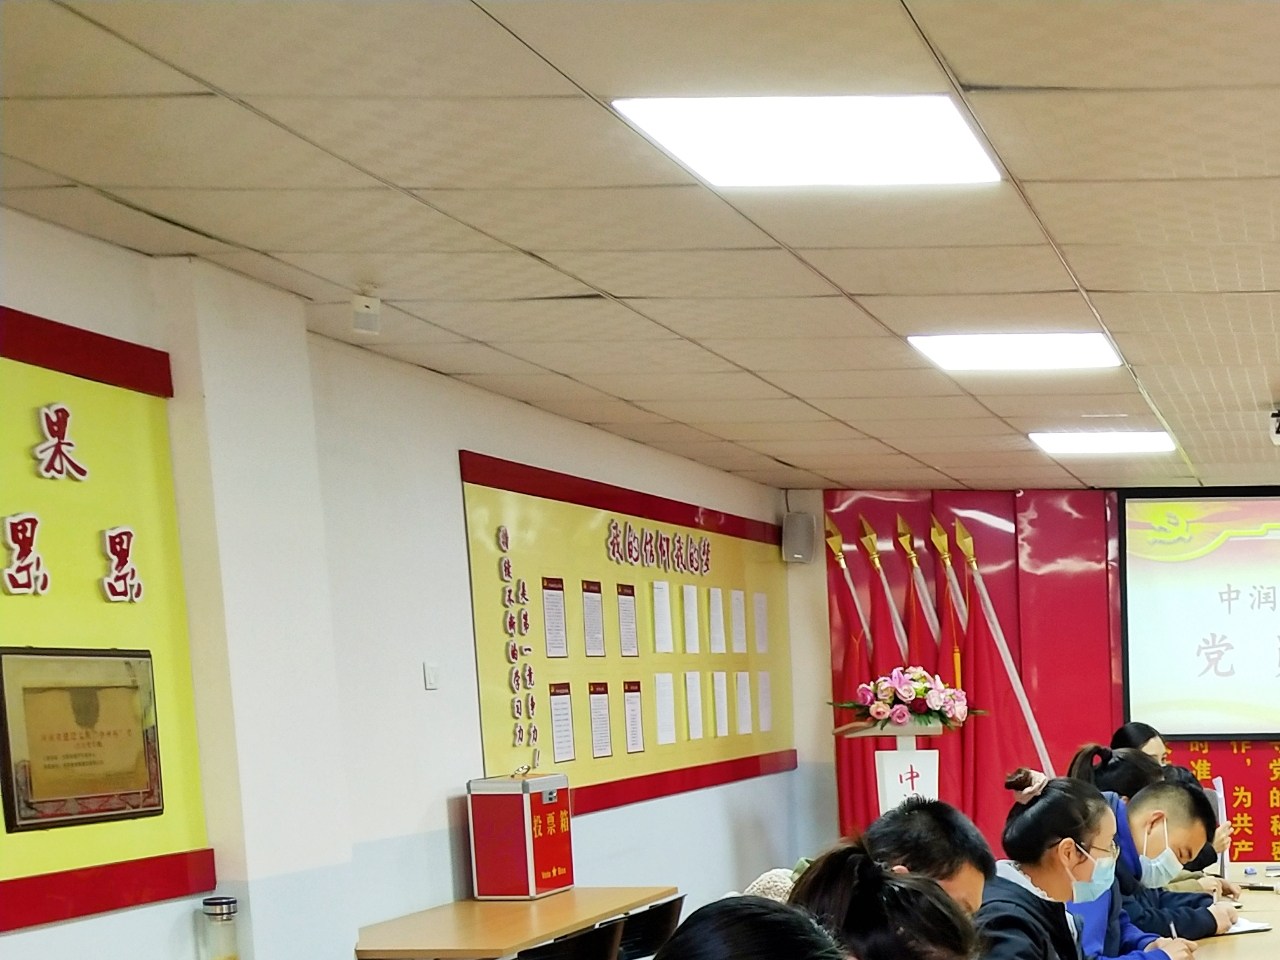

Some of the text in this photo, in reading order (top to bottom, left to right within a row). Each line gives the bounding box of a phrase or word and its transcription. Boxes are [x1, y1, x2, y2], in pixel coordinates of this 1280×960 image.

[35, 405, 88, 480] 果
[609, 520, 711, 575] 我的信仰我的梦
[899, 764, 920, 791] 中
[533, 809, 569, 838] 投票箱
